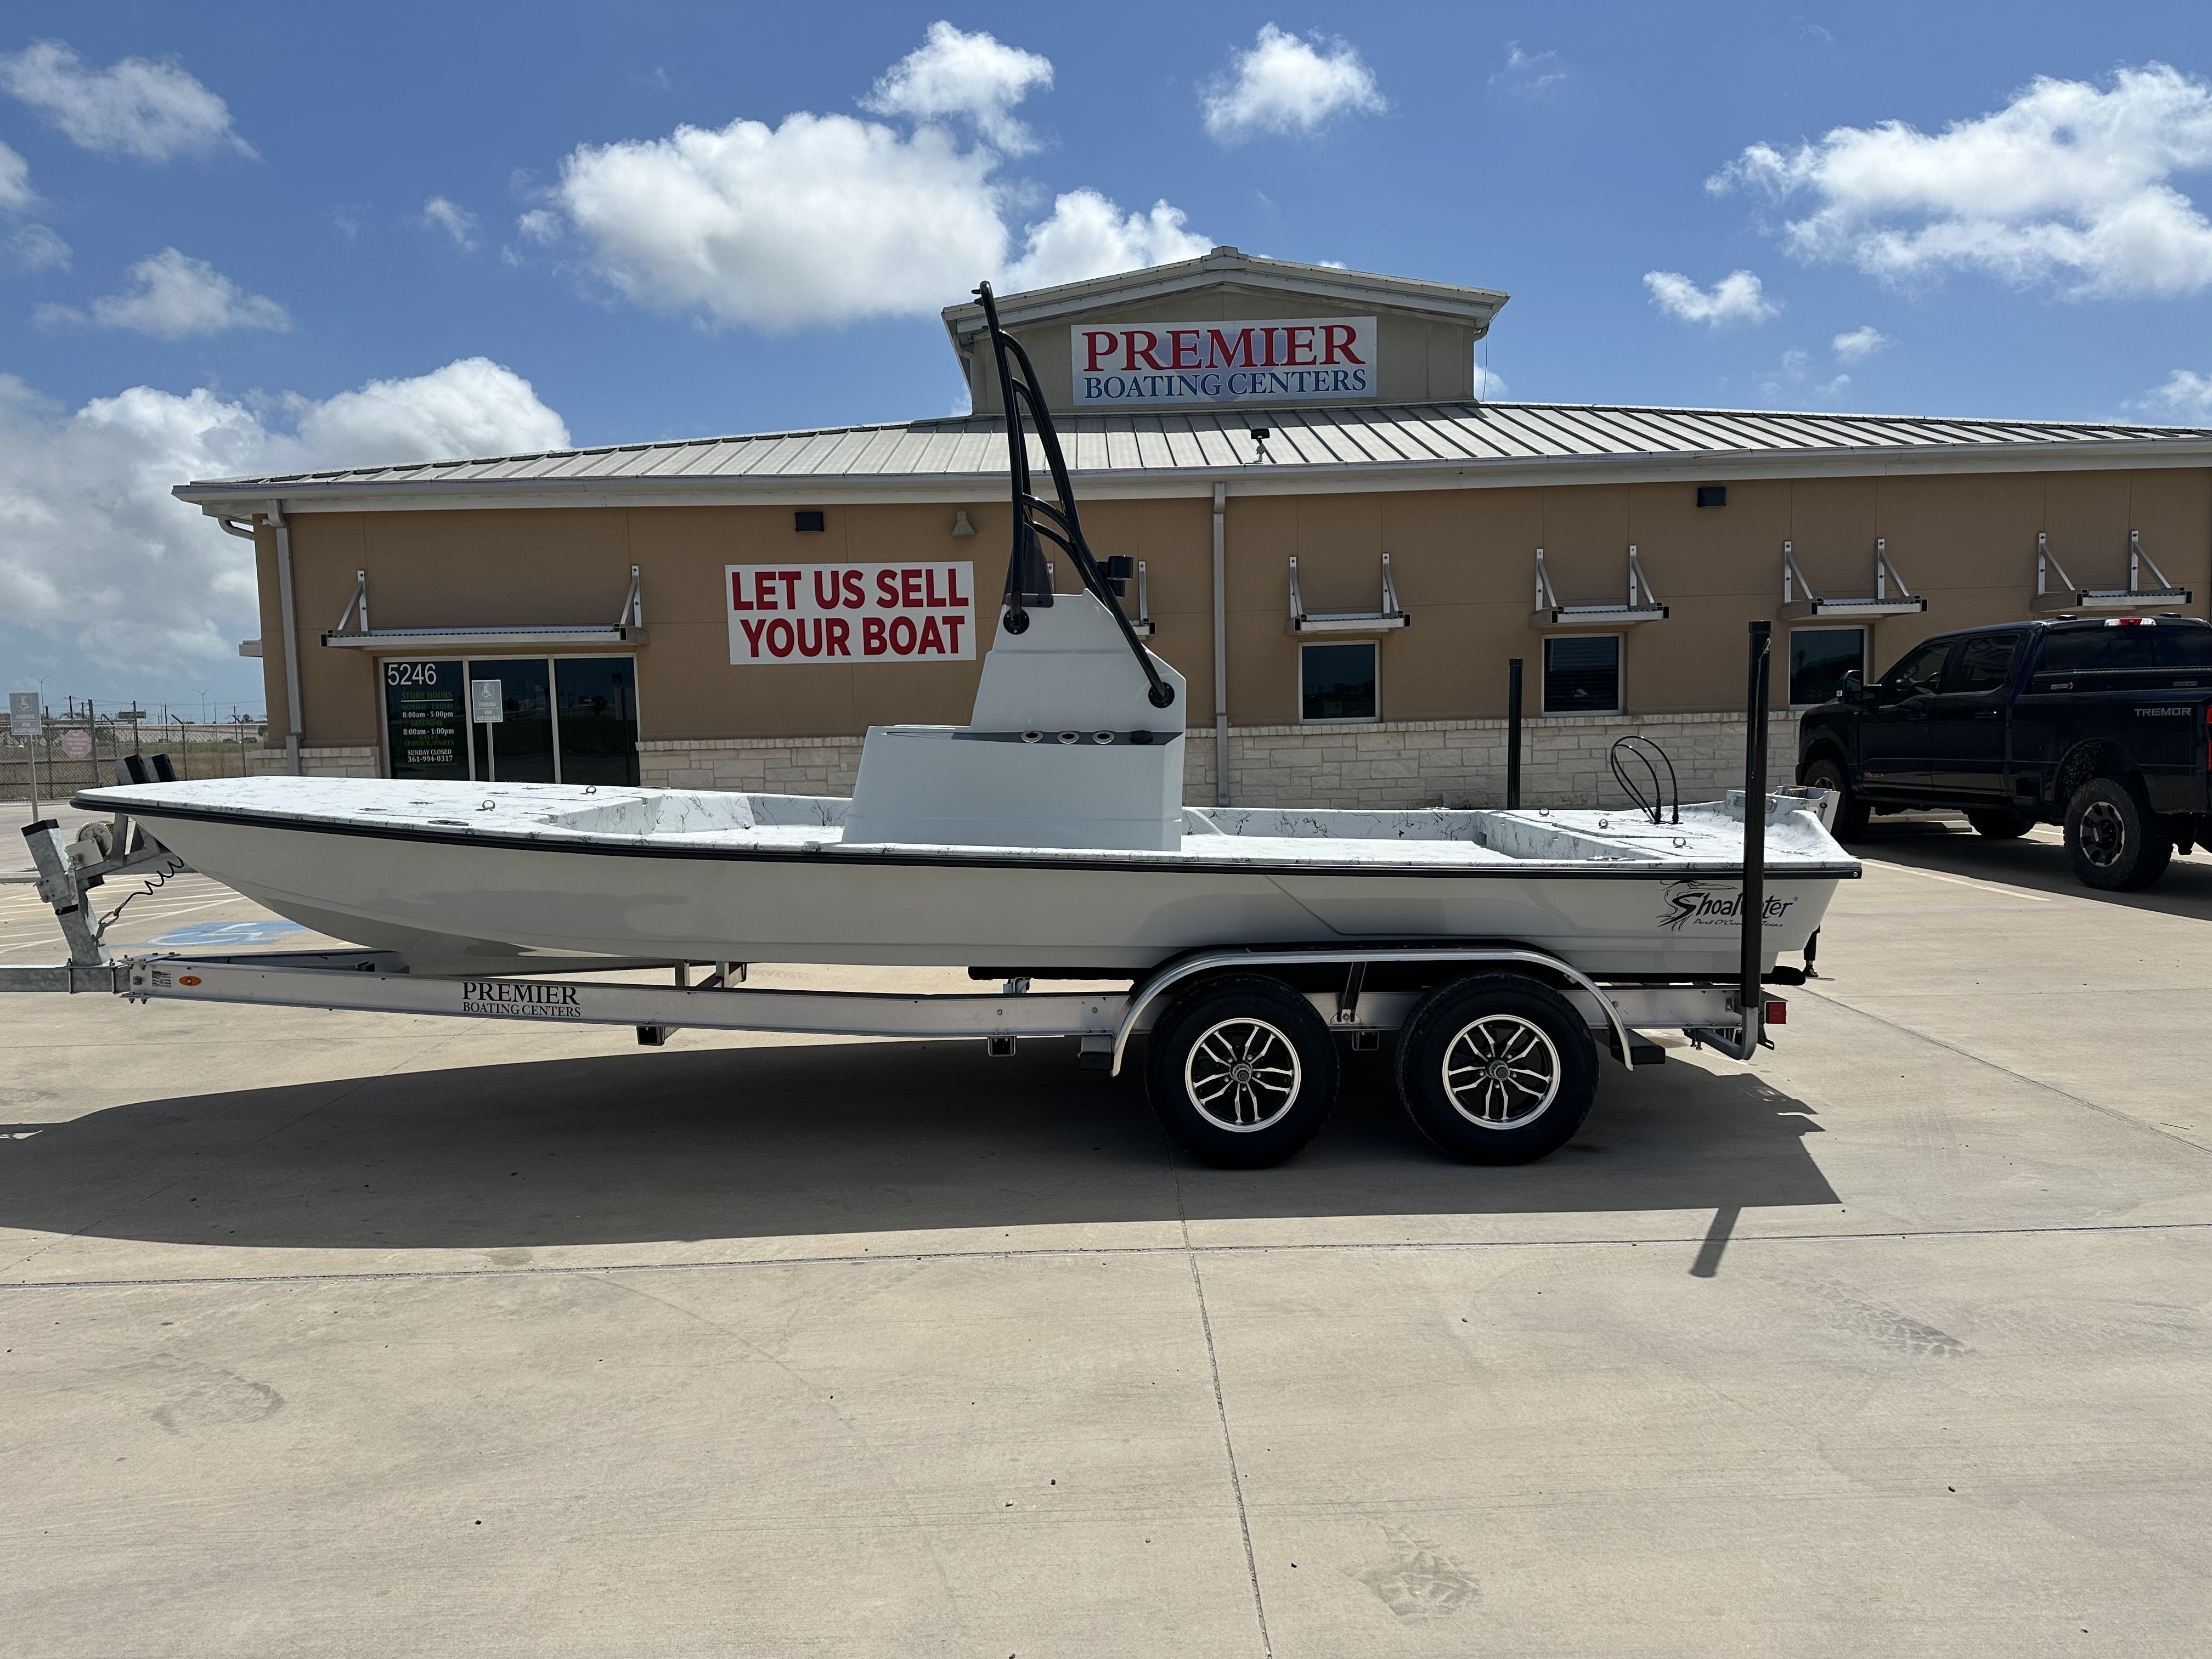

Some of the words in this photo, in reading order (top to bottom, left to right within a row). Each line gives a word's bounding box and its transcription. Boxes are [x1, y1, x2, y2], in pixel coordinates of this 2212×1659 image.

[1082, 324, 1366, 371] PREMIER
[1084, 373, 1222, 399] BOATING
[1228, 369, 1367, 395] CENTERS
[732, 571, 802, 611] LET
[814, 570, 866, 610] US
[876, 568, 969, 609] SELL
[740, 618, 851, 657] YOUR
[862, 616, 965, 656] BOAT
[388, 663, 437, 686] 5246
[2134, 708, 2192, 716] TREMOR
[431, 727, 454, 736] 1:00pm
[1657, 893, 1793, 927] Shoalter
[462, 982, 580, 1005] PREMIER
[462, 1002, 520, 1015] BOATING
[522, 1005, 581, 1017] CENTERS
